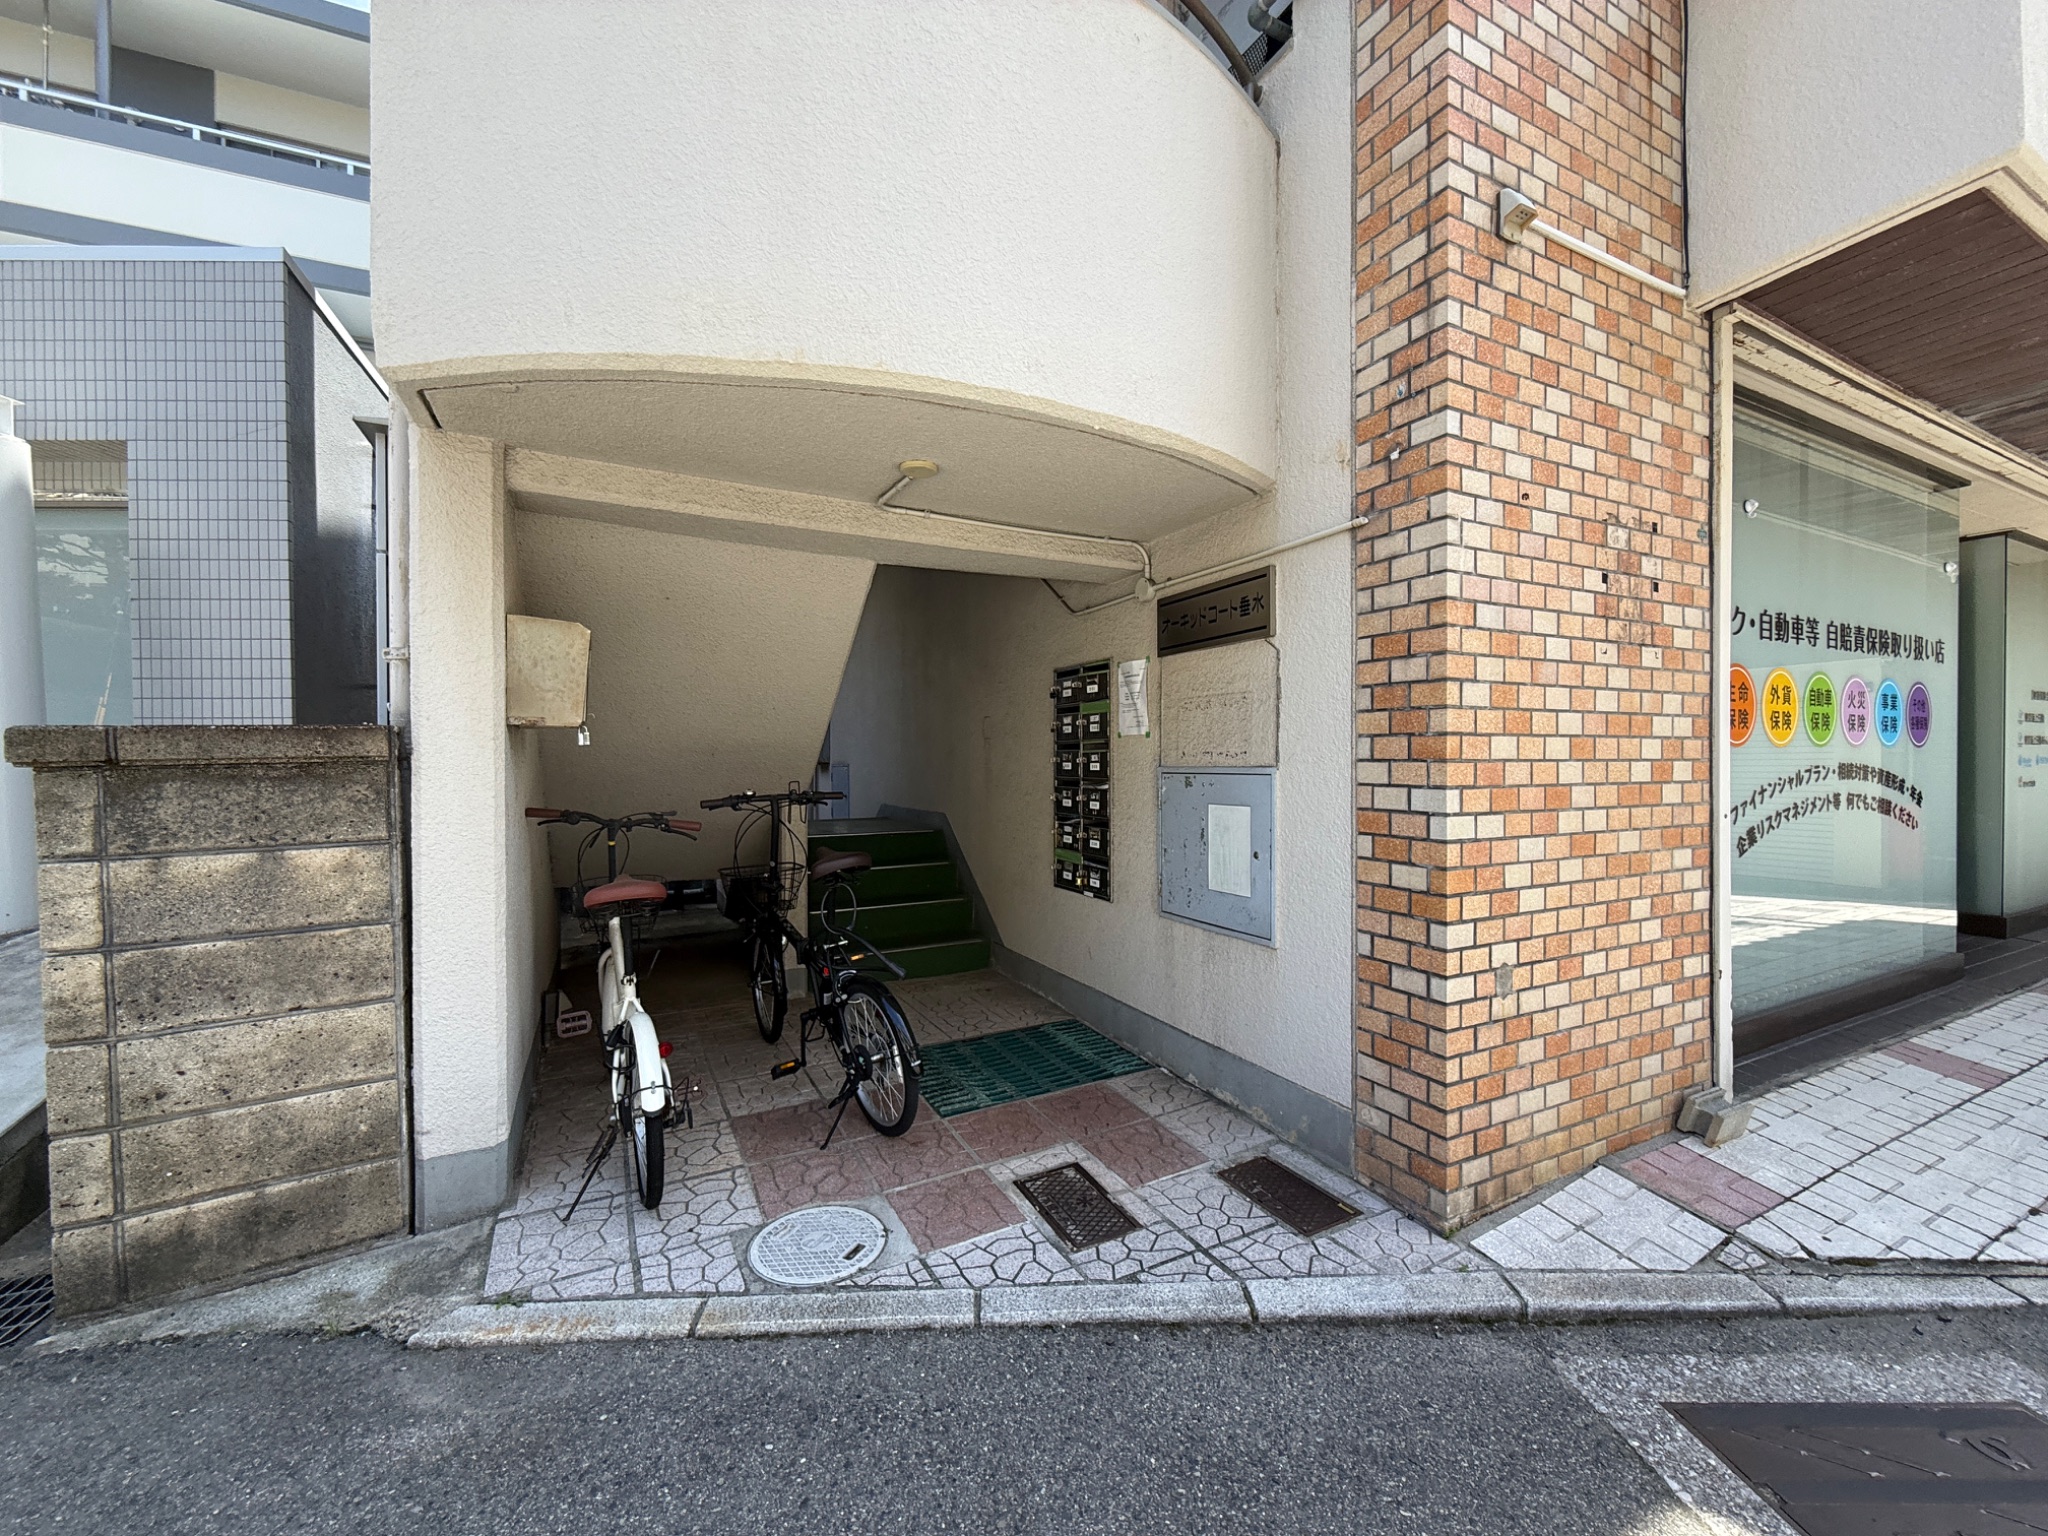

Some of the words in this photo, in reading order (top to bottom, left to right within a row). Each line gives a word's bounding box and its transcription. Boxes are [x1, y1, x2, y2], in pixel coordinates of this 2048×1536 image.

[1161, 591, 1265, 635] オーキッドコート垂水
[1826, 620, 1945, 664] 自賠責保険取り扱い店
[1770, 684, 1792, 706] 外貨
[1809, 687, 1833, 708] 自動車
[1847, 690, 1866, 710] 火災
[1881, 693, 1898, 711] 事業
[1770, 710, 1792, 731] 保険
[1810, 711, 1831, 732] 保険
[1847, 713, 1866, 733] 保険
[1881, 715, 1898, 734] 保険
[1736, 792, 1842, 859] 企業リスクマネジメント等
[1846, 792, 1919, 831] 何でもご相談ください
